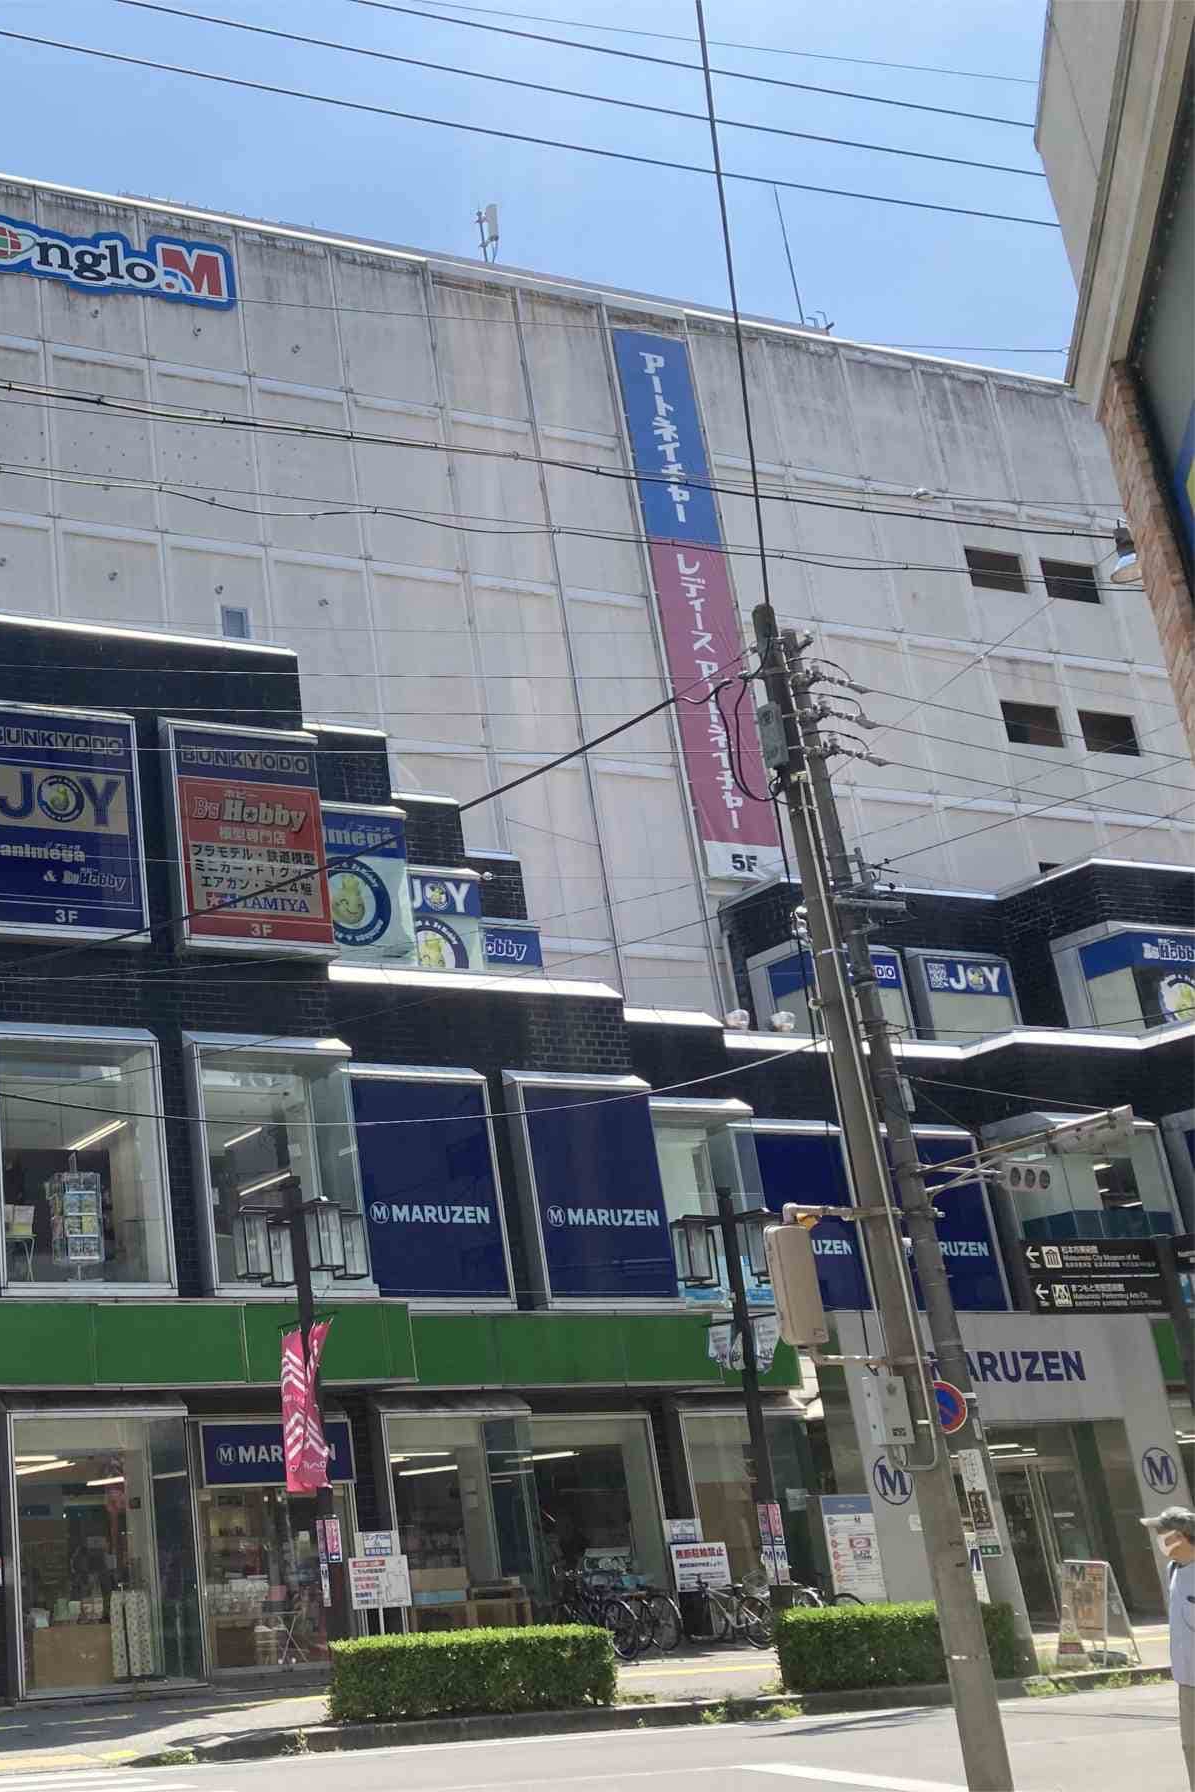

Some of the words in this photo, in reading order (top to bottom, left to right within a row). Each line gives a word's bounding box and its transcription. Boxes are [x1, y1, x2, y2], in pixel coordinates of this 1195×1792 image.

[639, 351, 691, 523] アートネイチャー
[180, 745, 308, 774] BUNKYODO
[223, 798, 306, 832] Hobby
[0, 843, 87, 864] animega
[732, 854, 759, 874] 5F
[43, 869, 57, 882] &
[240, 892, 310, 913] TAMIYA
[412, 877, 472, 913] JOY
[55, 909, 79, 923] 3F
[251, 923, 273, 937] 3F
[949, 964, 1001, 993] JOY
[392, 1205, 491, 1225] MARUZEN
[568, 1207, 660, 1227] MARUZEN
